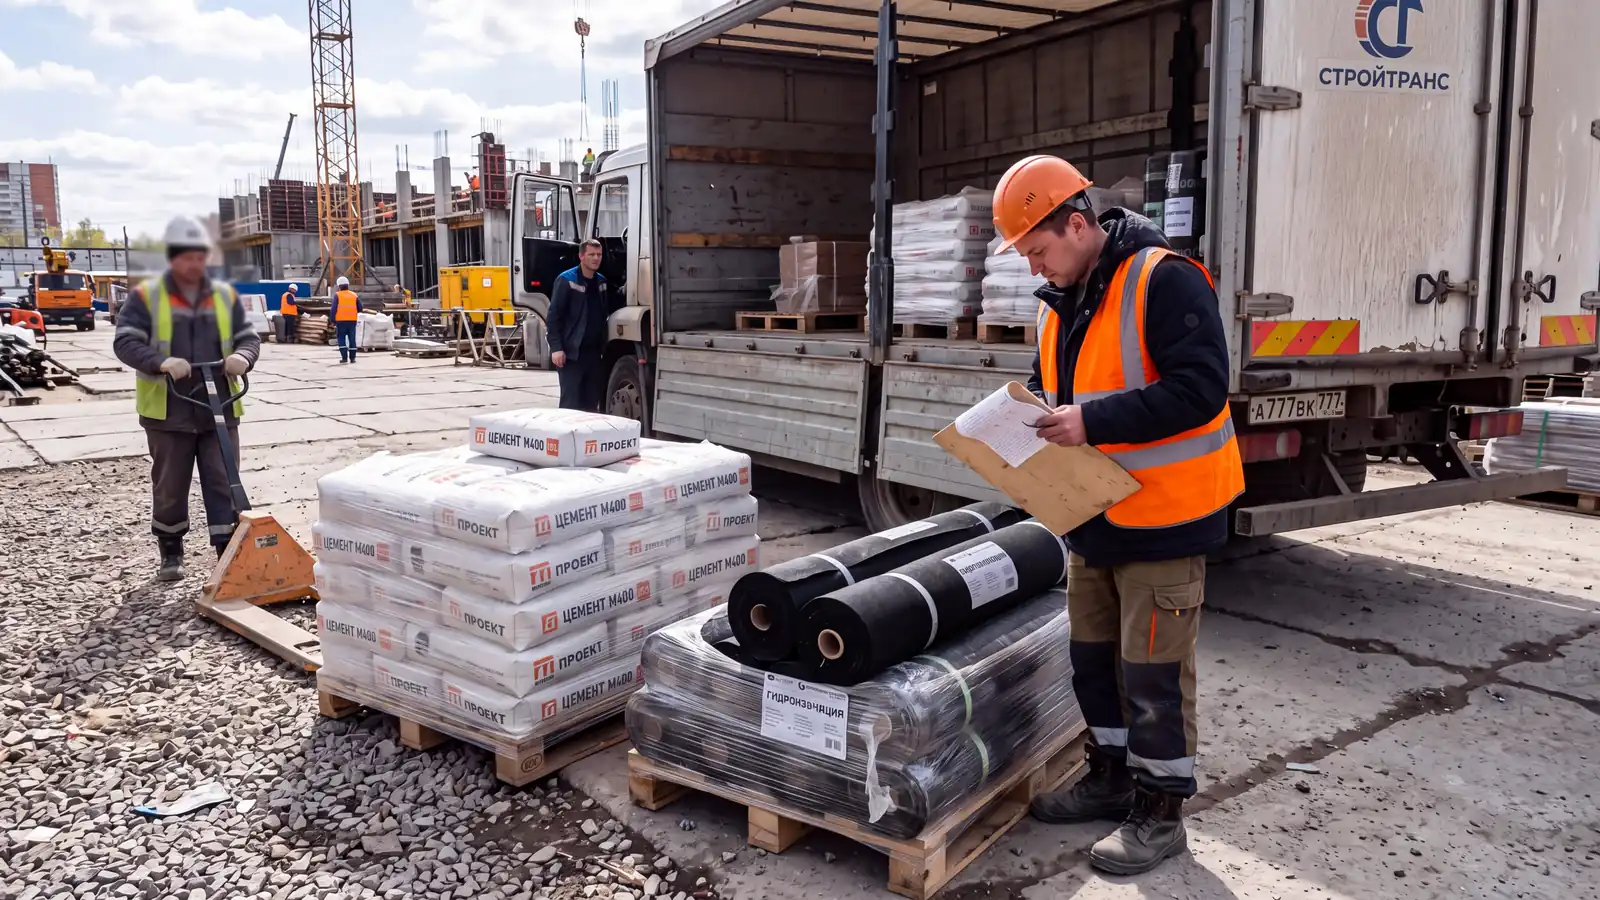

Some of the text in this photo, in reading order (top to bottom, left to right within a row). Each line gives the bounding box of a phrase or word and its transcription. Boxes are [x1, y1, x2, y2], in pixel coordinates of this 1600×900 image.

[1319, 65, 1450, 90] СТРОЙТРАНС
[1255, 392, 1341, 420] А777ВК 777
[488, 431, 522, 448] ЦЕМЕНТ
[523, 438, 545, 451] М400
[600, 438, 637, 452] ПРОЕКТ
[680, 472, 738, 498] ЦЕМЕНТ М400
[554, 504, 598, 529] ЦЕМЕНТ
[600, 498, 627, 516] М400
[723, 513, 756, 527] ПРОЕКТ
[457, 518, 500, 539] ПРОЕКТ
[323, 535, 376, 557] ЦЕМЕНТ М400
[555, 550, 600, 577] ПРОЕКТ
[688, 553, 747, 582] ЦЕМЕНТ М400
[562, 596, 606, 624] ЦЕМЕНТ
[608, 587, 635, 607] М400
[325, 619, 355, 638] ЦЕМЕНТ
[463, 612, 506, 637] ПРОЕКТ
[558, 640, 603, 671] ПРОЕКТ
[561, 670, 634, 710] ЦЕМЕНТ М400
[463, 703, 507, 725] ПРОЕКТ
